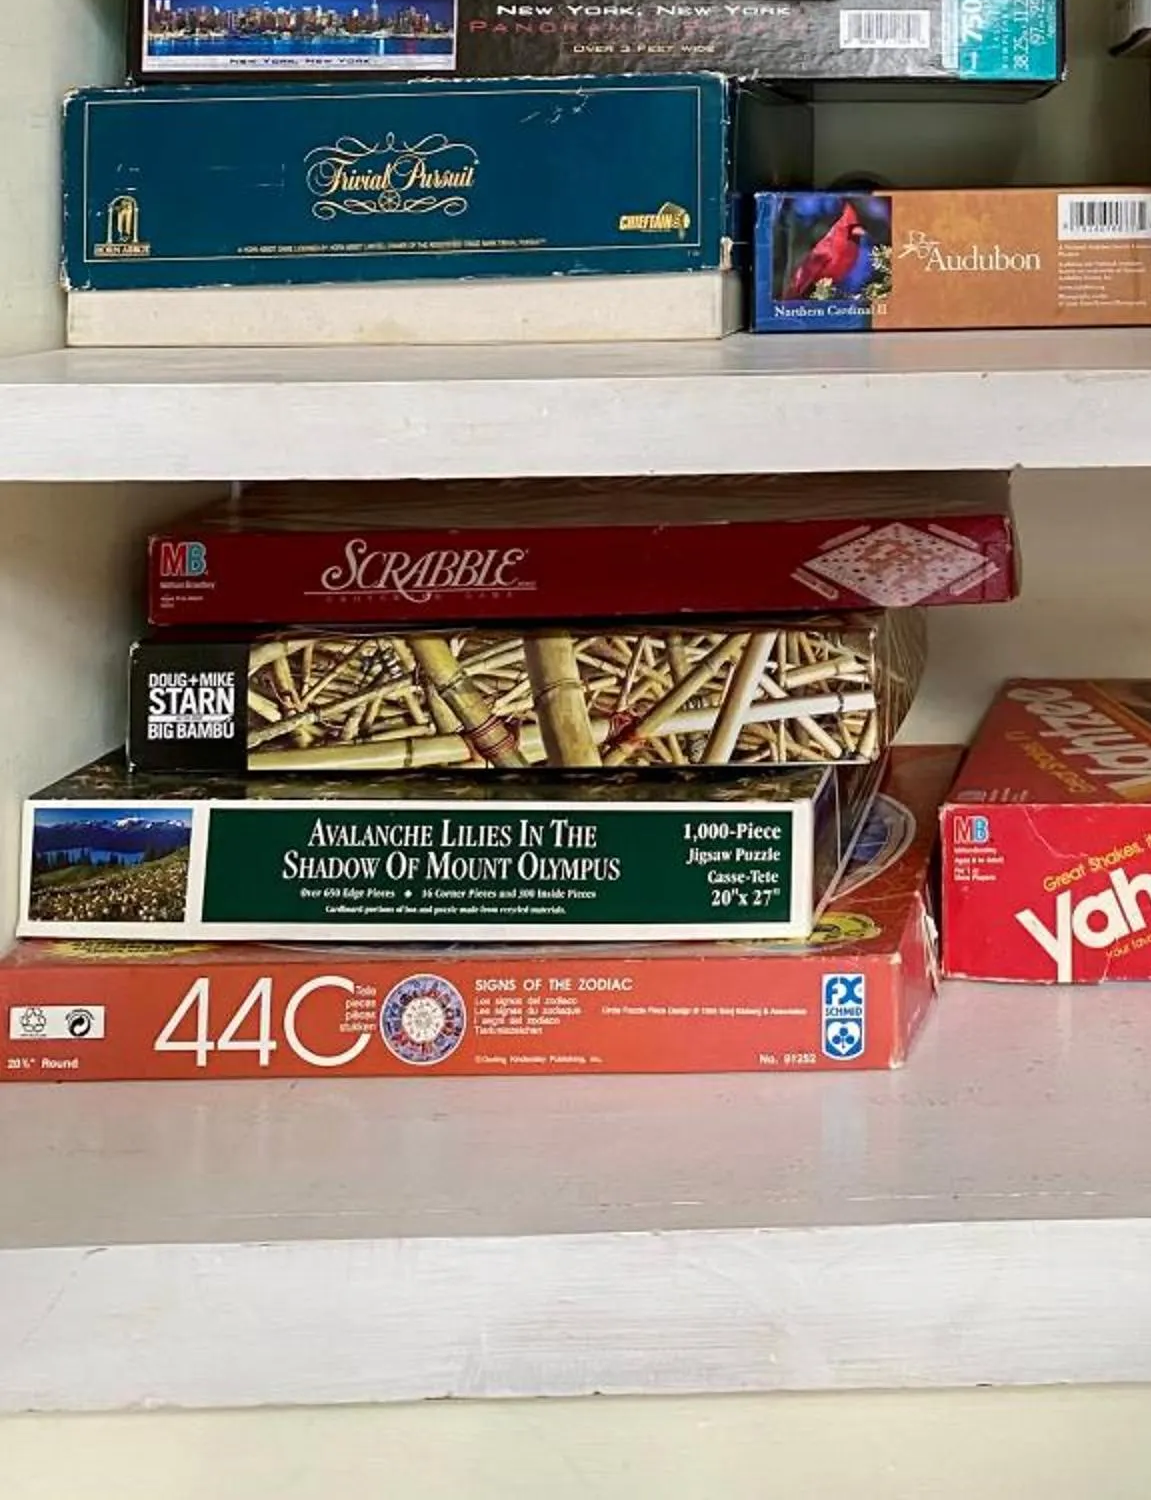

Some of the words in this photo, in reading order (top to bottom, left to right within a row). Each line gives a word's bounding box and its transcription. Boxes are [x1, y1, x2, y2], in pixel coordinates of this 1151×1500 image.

[305, 156, 391, 197] Trivial
[393, 154, 480, 192] Pursuit
[925, 245, 1042, 273] Audubon
[774, 305, 824, 318] Northern
[826, 304, 874, 318] Cardinal
[160, 541, 207, 577] MB
[321, 538, 528, 604] SCRABBLE
[149, 687, 235, 716] STARN
[147, 722, 174, 739] BIG
[177, 721, 235, 739] BAMBU
[308, 818, 433, 848] AVALANCHE
[441, 819, 512, 847] LILIES
[550, 819, 598, 848] THE
[683, 822, 782, 842] 1,000-Piece
[953, 815, 990, 845] MB
[282, 850, 381, 880] SHADOW
[385, 851, 421, 880] OF
[425, 851, 513, 880] MOUNT
[517, 850, 621, 881] OLYMPUS
[686, 848, 732, 865] Jigsaw
[735, 848, 781, 861] Puzzle
[707, 869, 779, 884] Casse-Tete
[1043, 864, 1086, 893] Great
[753, 887, 781, 907] 27"
[1105, 941, 1130, 959] your
[474, 979, 516, 992] SIGNS
[523, 979, 543, 991] OF
[549, 979, 572, 991] THE
[578, 978, 633, 991] ZODIAC
[824, 1006, 862, 1017] SCHMID
[41, 1057, 79, 1069] Round
[759, 1053, 779, 1064] No.
